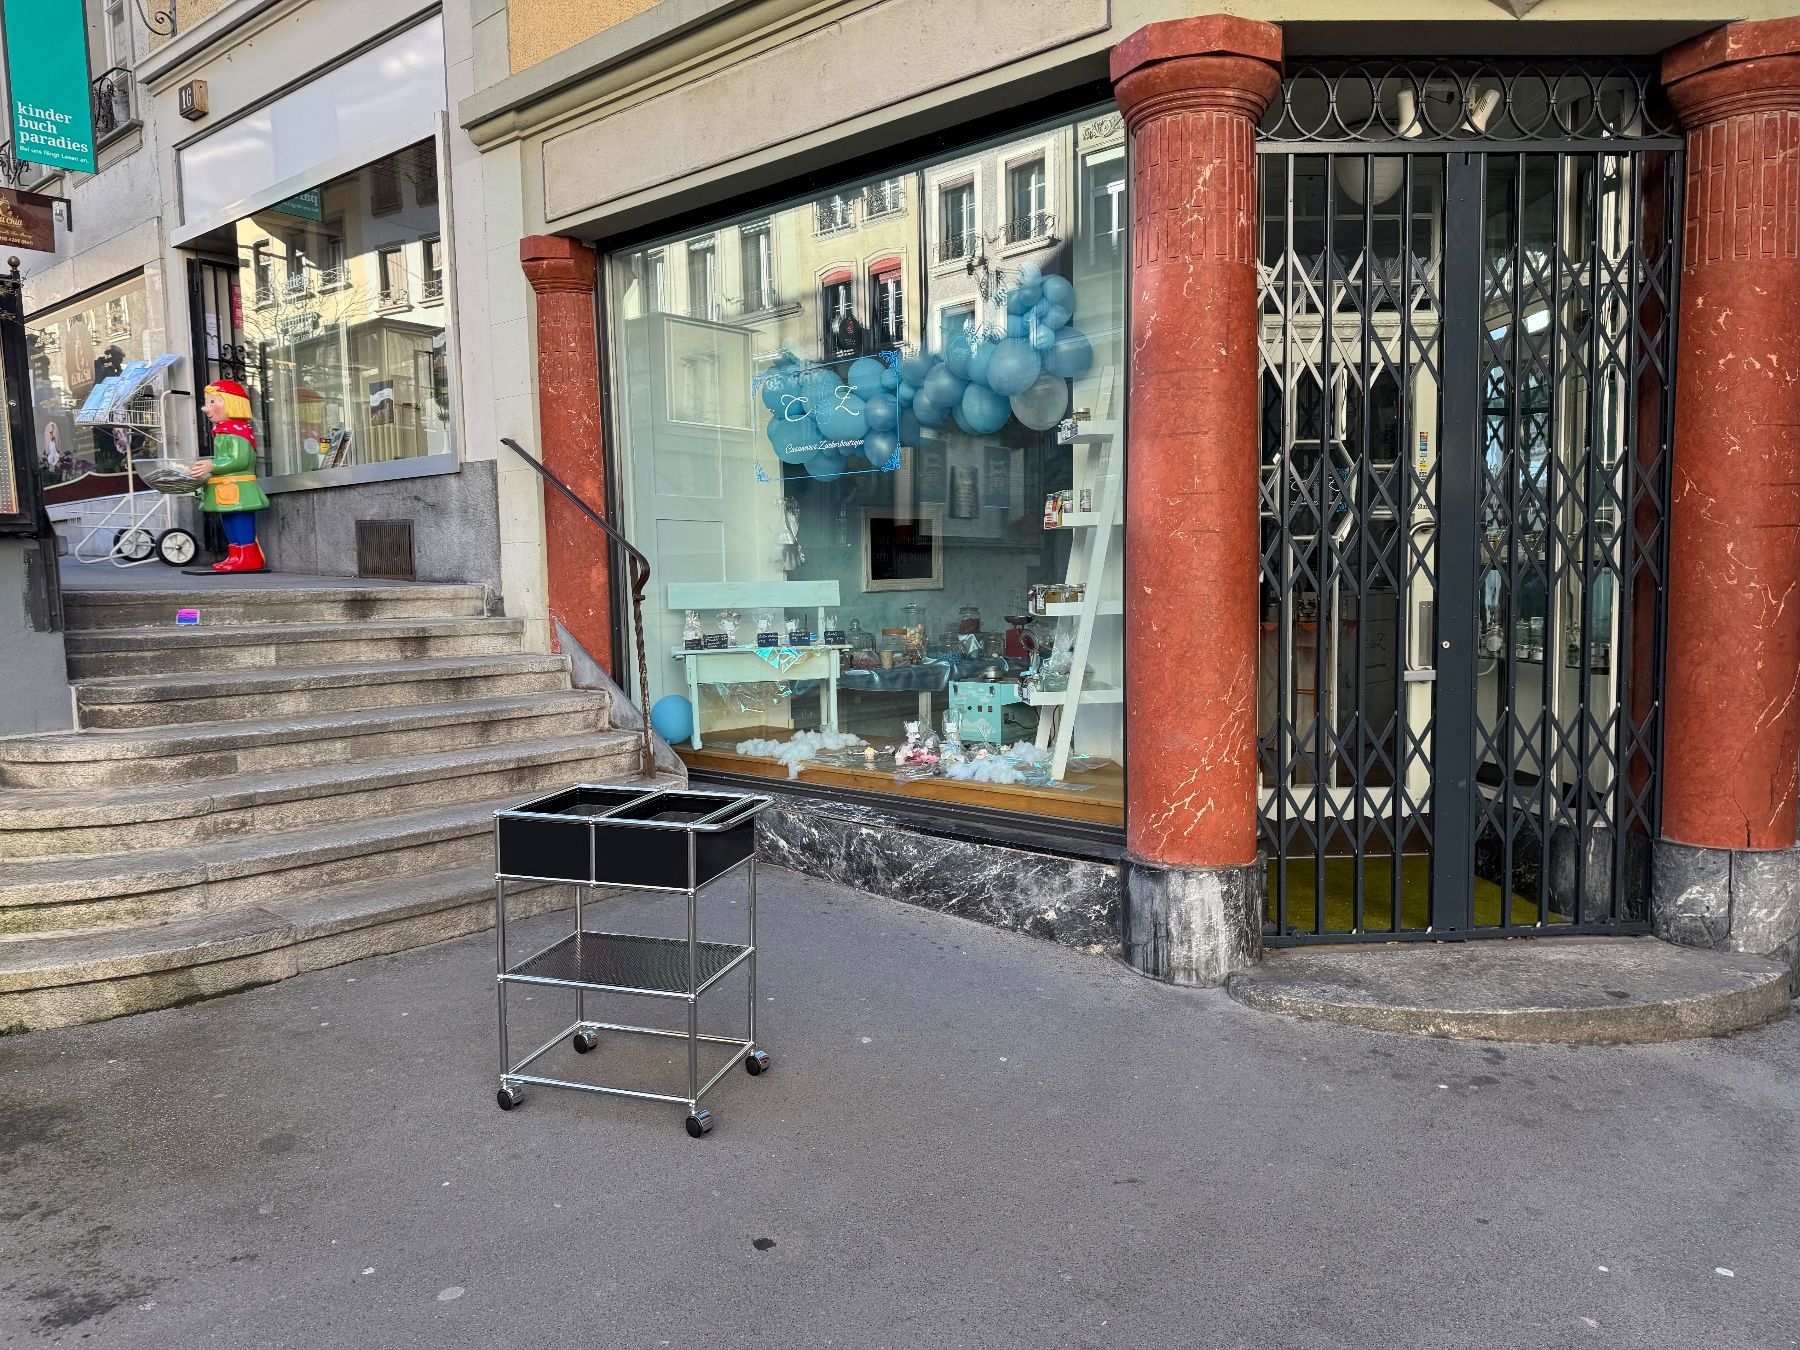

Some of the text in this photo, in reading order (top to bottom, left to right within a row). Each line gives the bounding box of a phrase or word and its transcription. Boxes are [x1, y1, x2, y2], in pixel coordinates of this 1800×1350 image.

[181, 87, 192, 109] 16
[16, 101, 72, 124] kinder
[18, 115, 58, 134] buch
[18, 130, 89, 153] paradies
